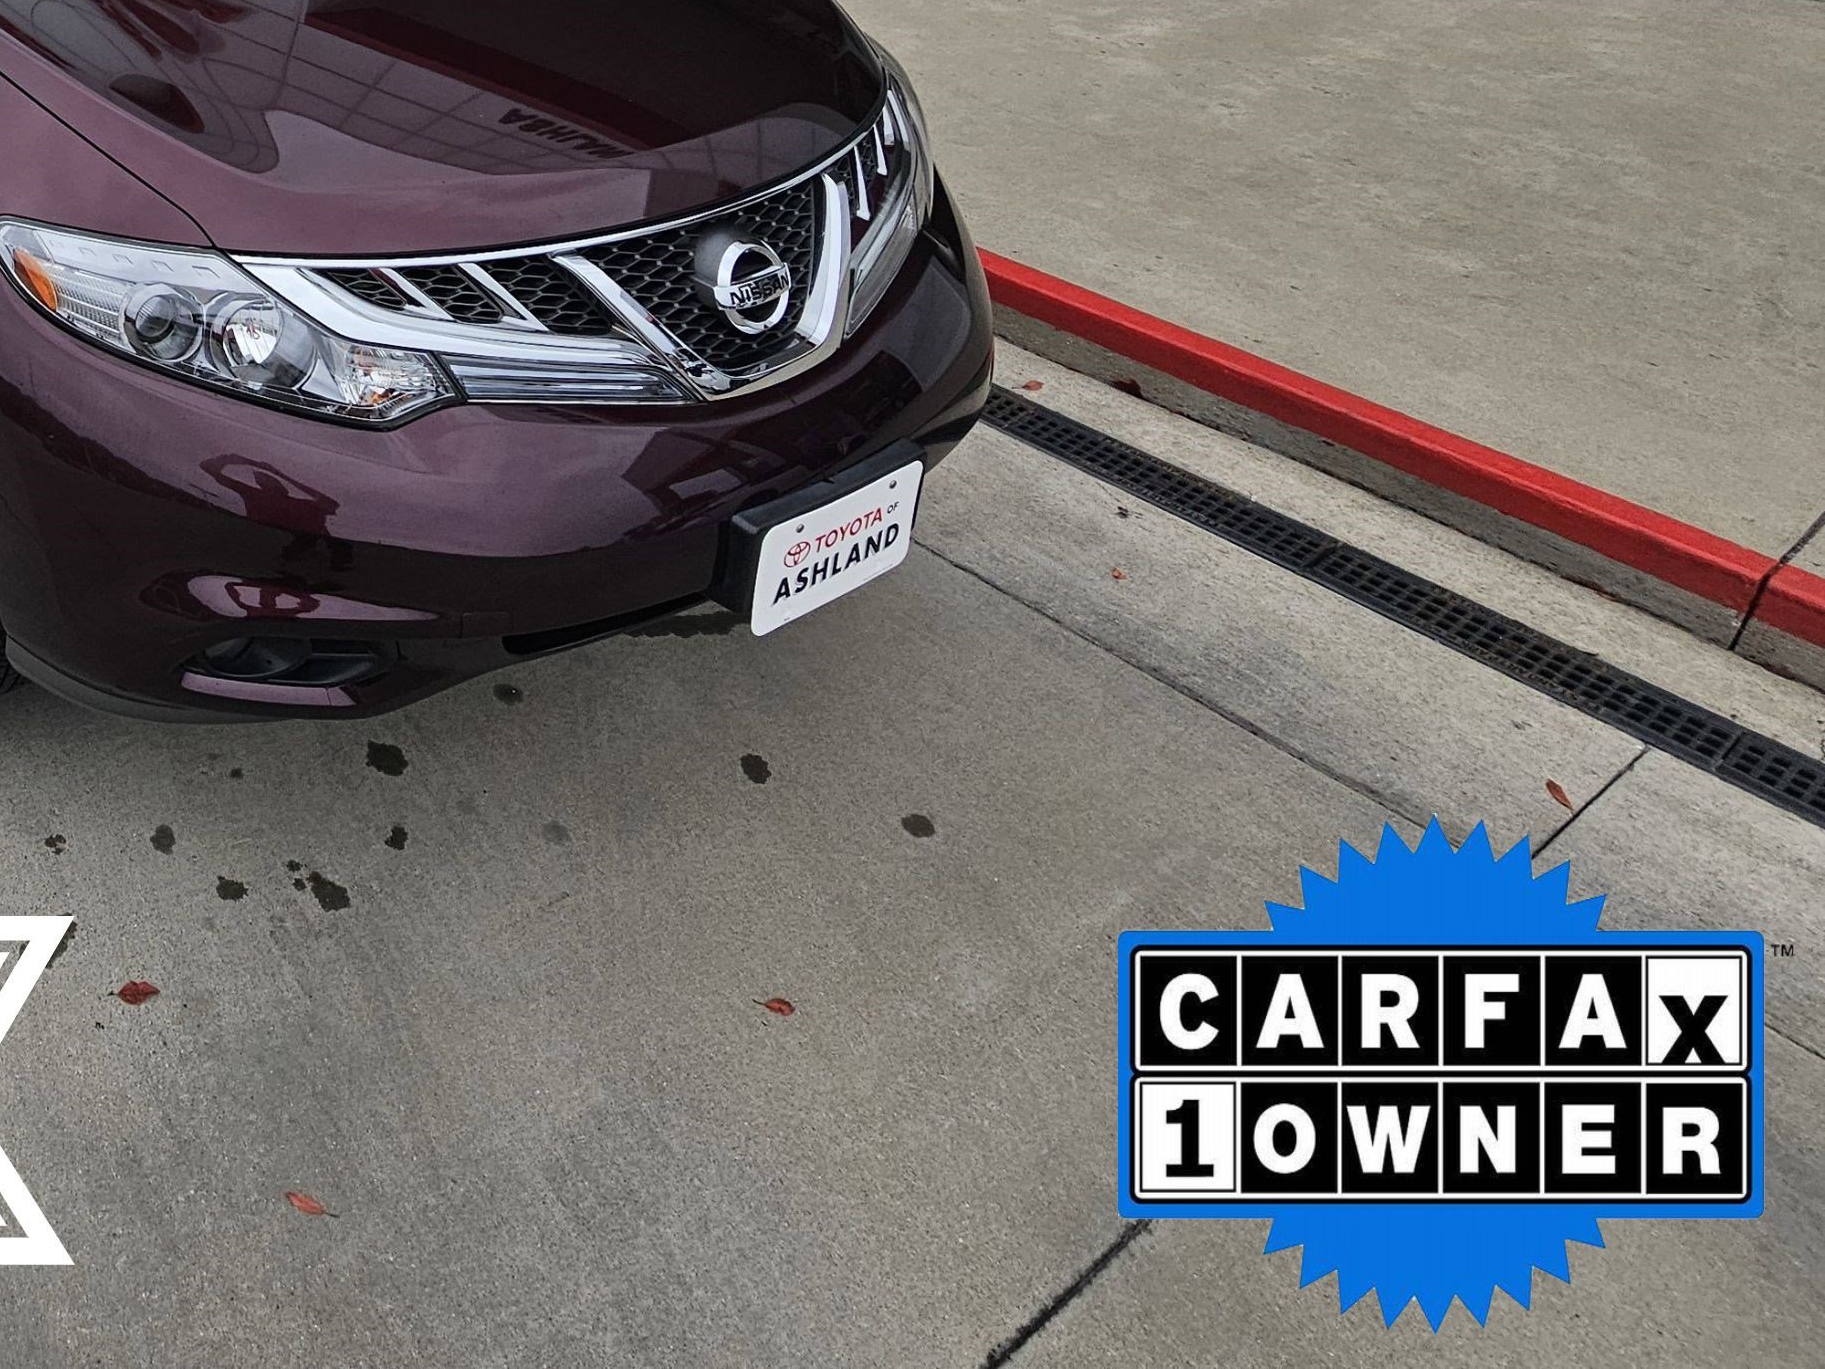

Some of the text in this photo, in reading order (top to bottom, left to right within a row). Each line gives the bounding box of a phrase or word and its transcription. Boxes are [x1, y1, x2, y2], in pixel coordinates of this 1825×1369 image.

[730, 273, 790, 305] NISSAN
[815, 501, 899, 553] TOYOTA OF
[772, 523, 900, 607] ASHLAND
